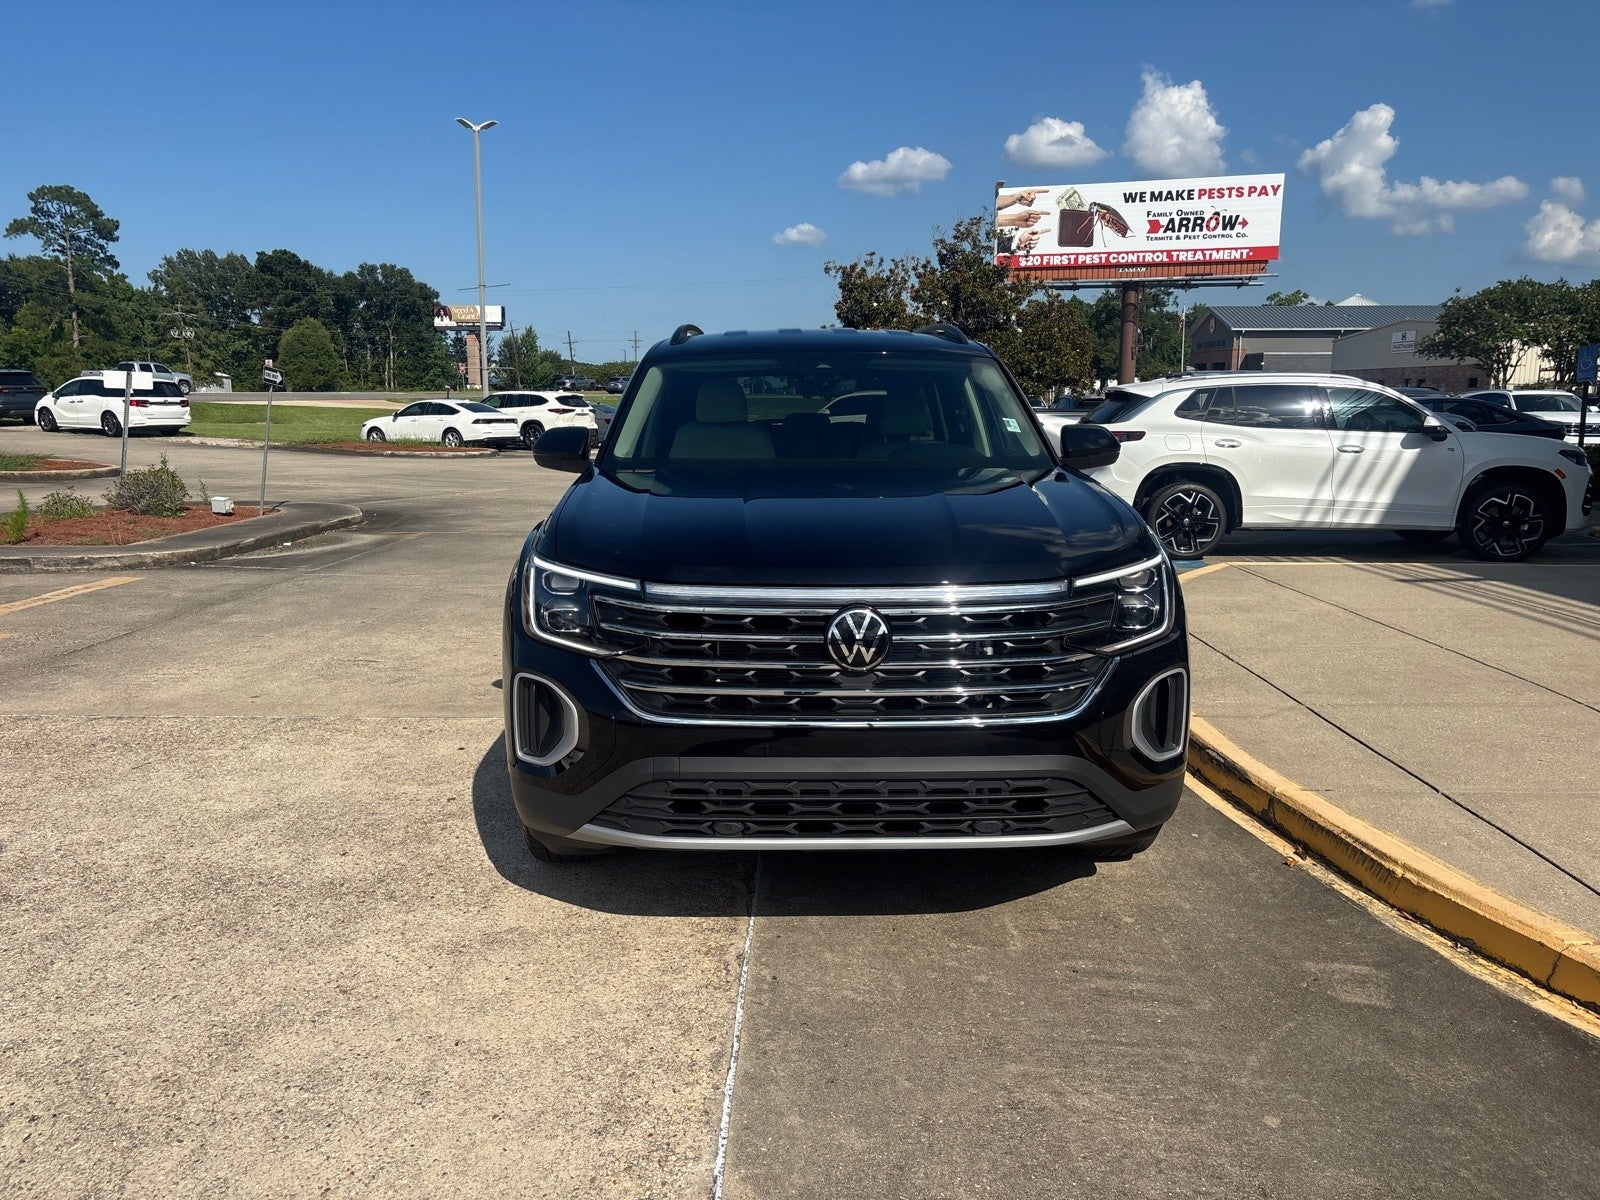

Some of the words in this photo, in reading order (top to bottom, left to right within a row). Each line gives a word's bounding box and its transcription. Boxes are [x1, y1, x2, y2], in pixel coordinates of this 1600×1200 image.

[1123, 192, 1147, 203] WE
[1150, 189, 1195, 202] MAKE
[1198, 186, 1245, 200] PESTS
[1248, 184, 1282, 197] PAY
[1146, 210, 1173, 218] FAMILY
[1176, 209, 1204, 217] OWNED
[1163, 214, 1240, 234] ARROW
[1019, 256, 1040, 267] $20
[1042, 255, 1076, 266] FIRST
[1078, 253, 1108, 265] PEST
[1109, 251, 1169, 264] CONTROL
